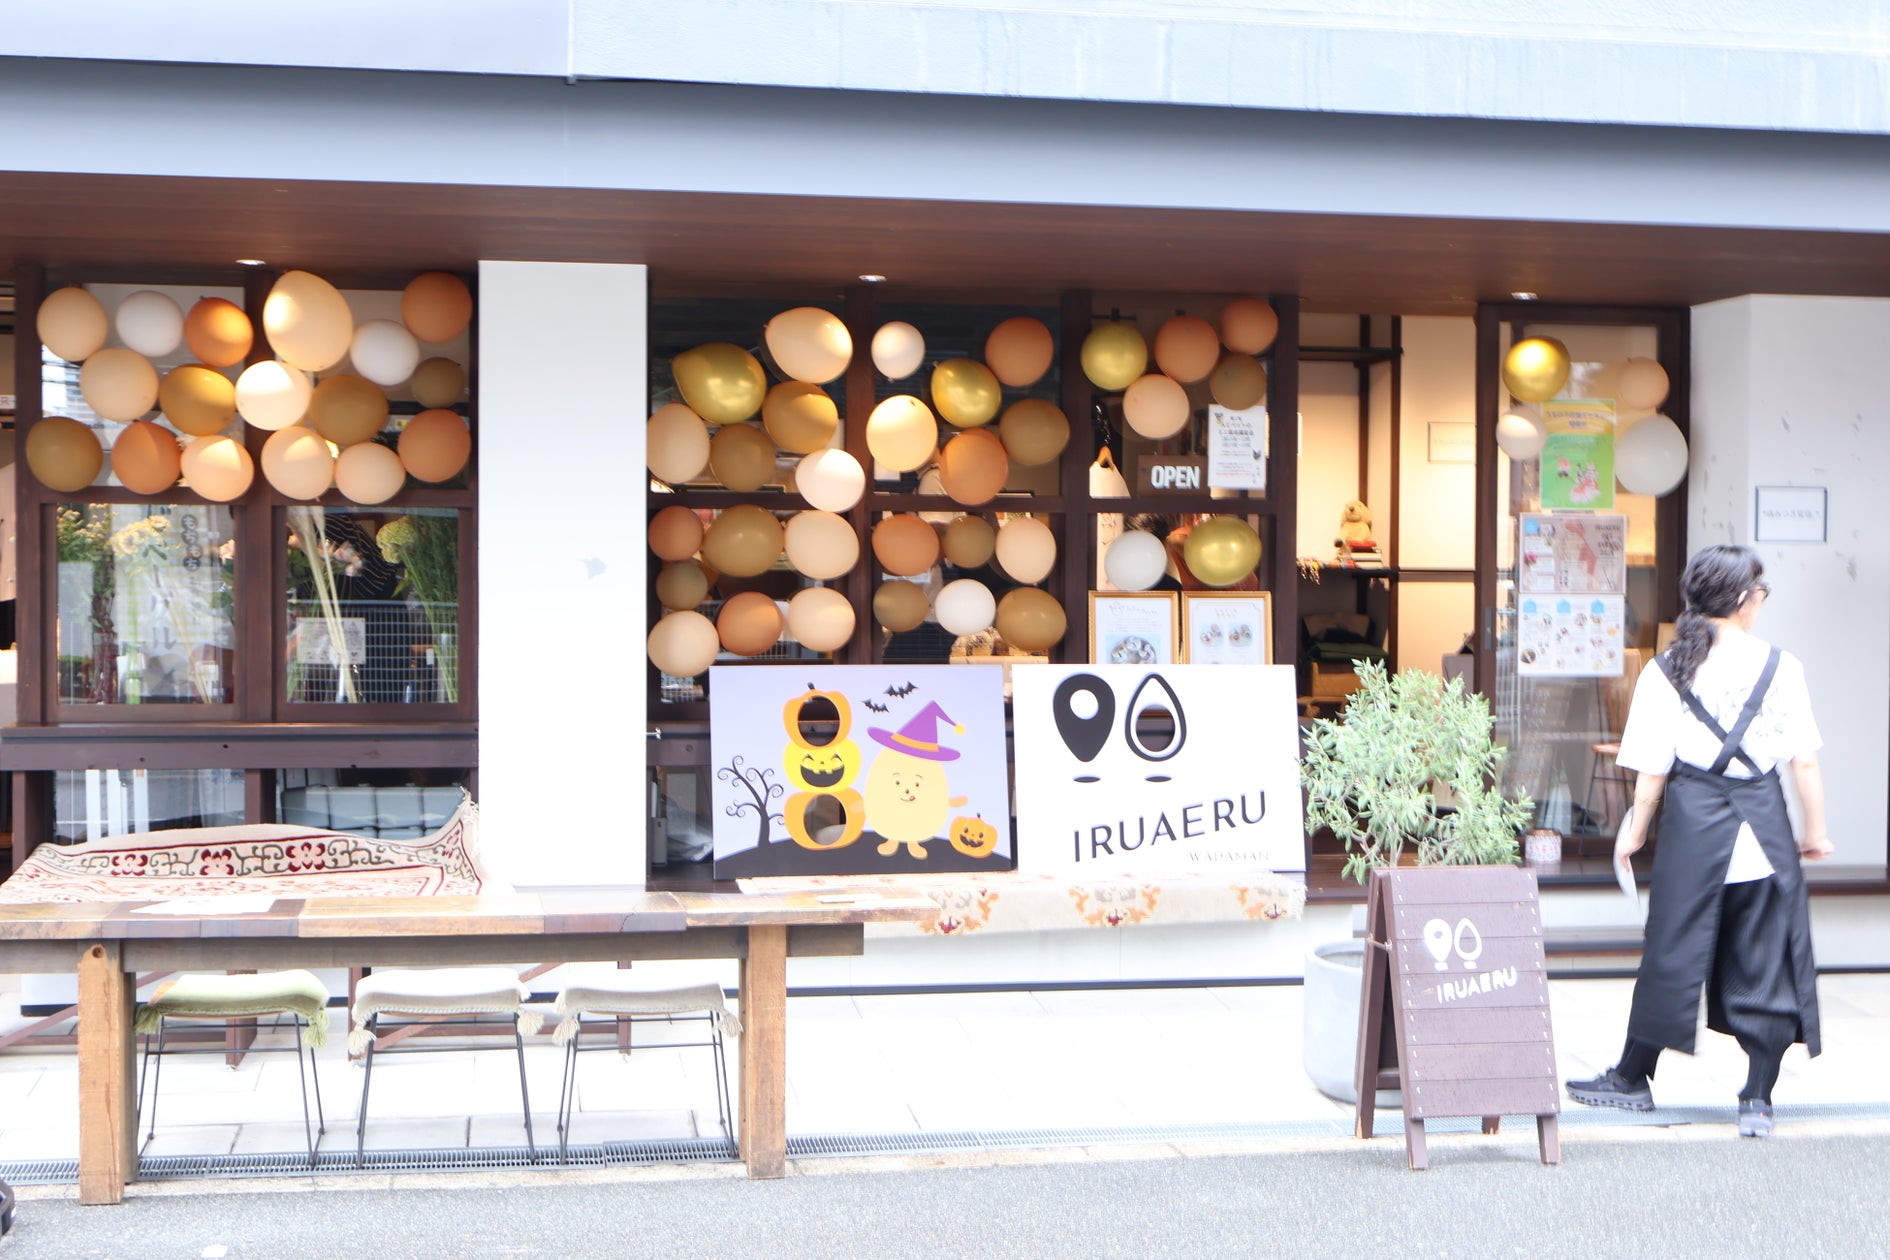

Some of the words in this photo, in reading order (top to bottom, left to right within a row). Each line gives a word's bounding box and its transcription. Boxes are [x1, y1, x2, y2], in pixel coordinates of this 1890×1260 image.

[1151, 465, 1200, 489] OPEN
[181, 514, 204, 572] もちもち
[1074, 790, 1267, 862] IRUAERU
[1436, 965, 1517, 1004] IRUAERU
